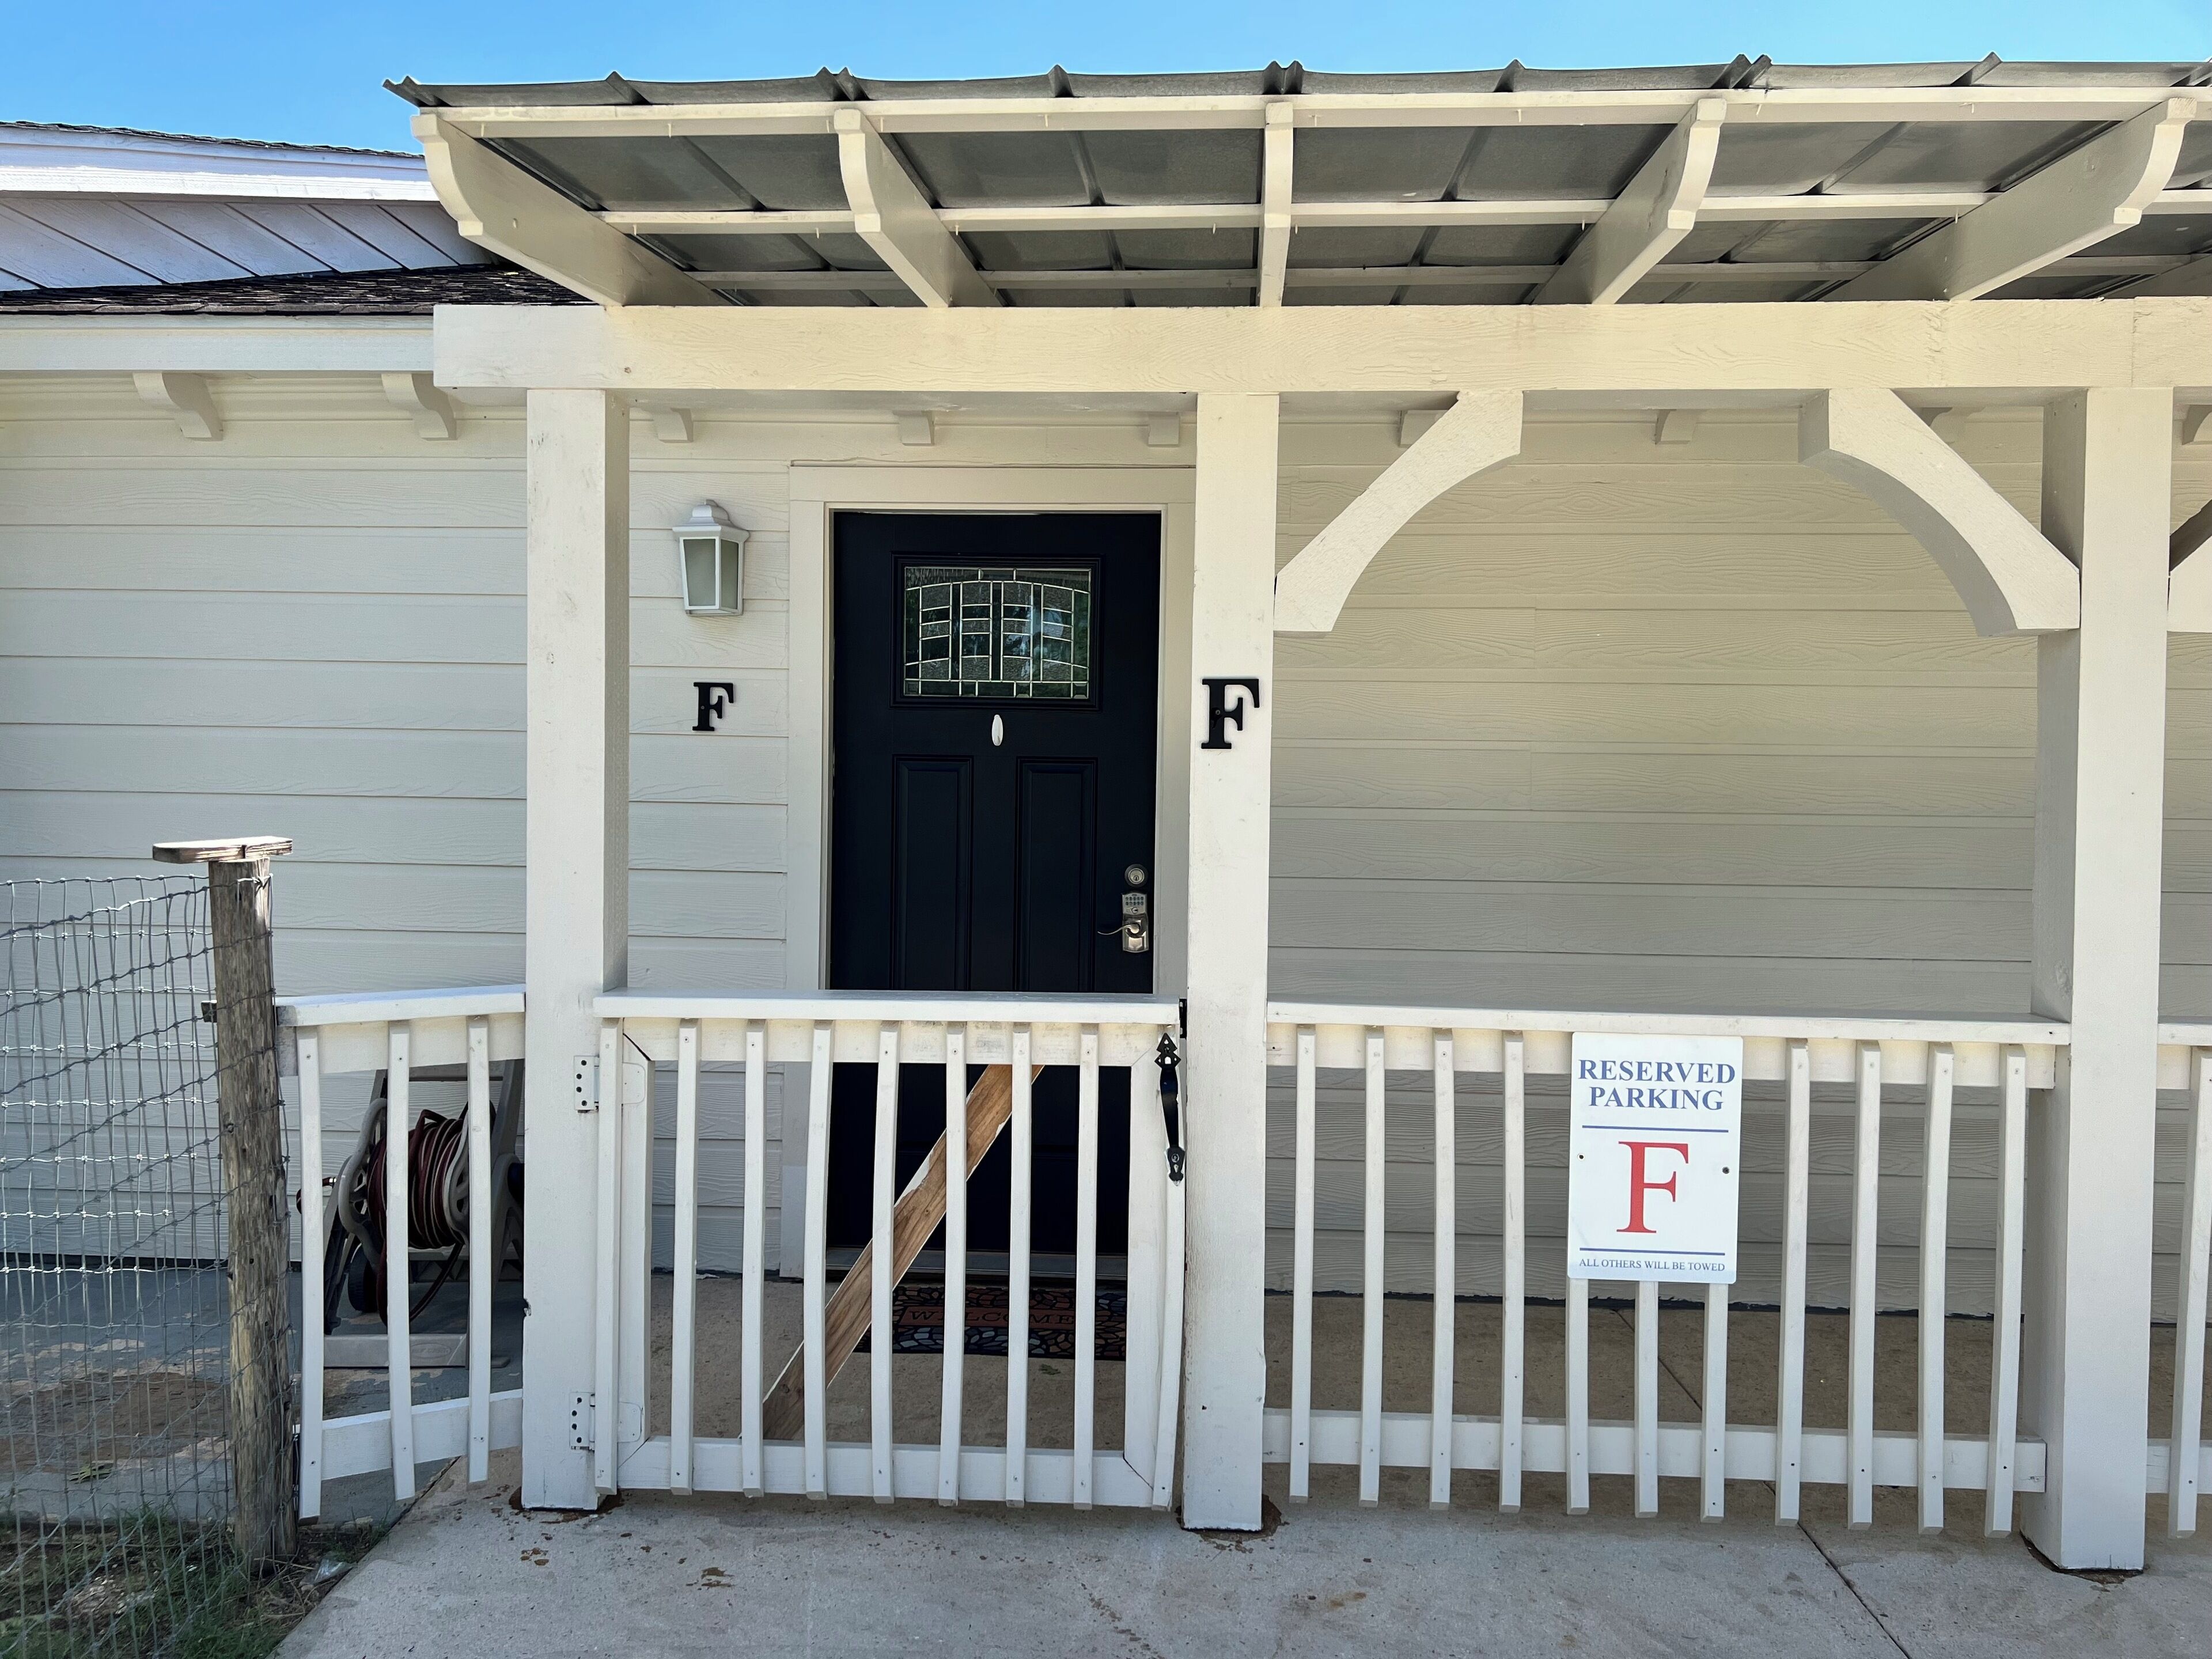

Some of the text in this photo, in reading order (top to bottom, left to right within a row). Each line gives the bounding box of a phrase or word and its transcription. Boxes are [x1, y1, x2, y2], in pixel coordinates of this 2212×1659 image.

[692, 682, 734, 731] F
[1201, 679, 1259, 749] F
[1579, 1059, 1735, 1084] RESERVED
[1589, 1087, 1723, 1111] PARKING
[1616, 1141, 1688, 1233] F
[1601, 1260, 1641, 1268] OTHERS
[1645, 1261, 1669, 1269] WILL
[1688, 1263, 1725, 1271] TOWED
[911, 1310, 1074, 1324] WLCME
